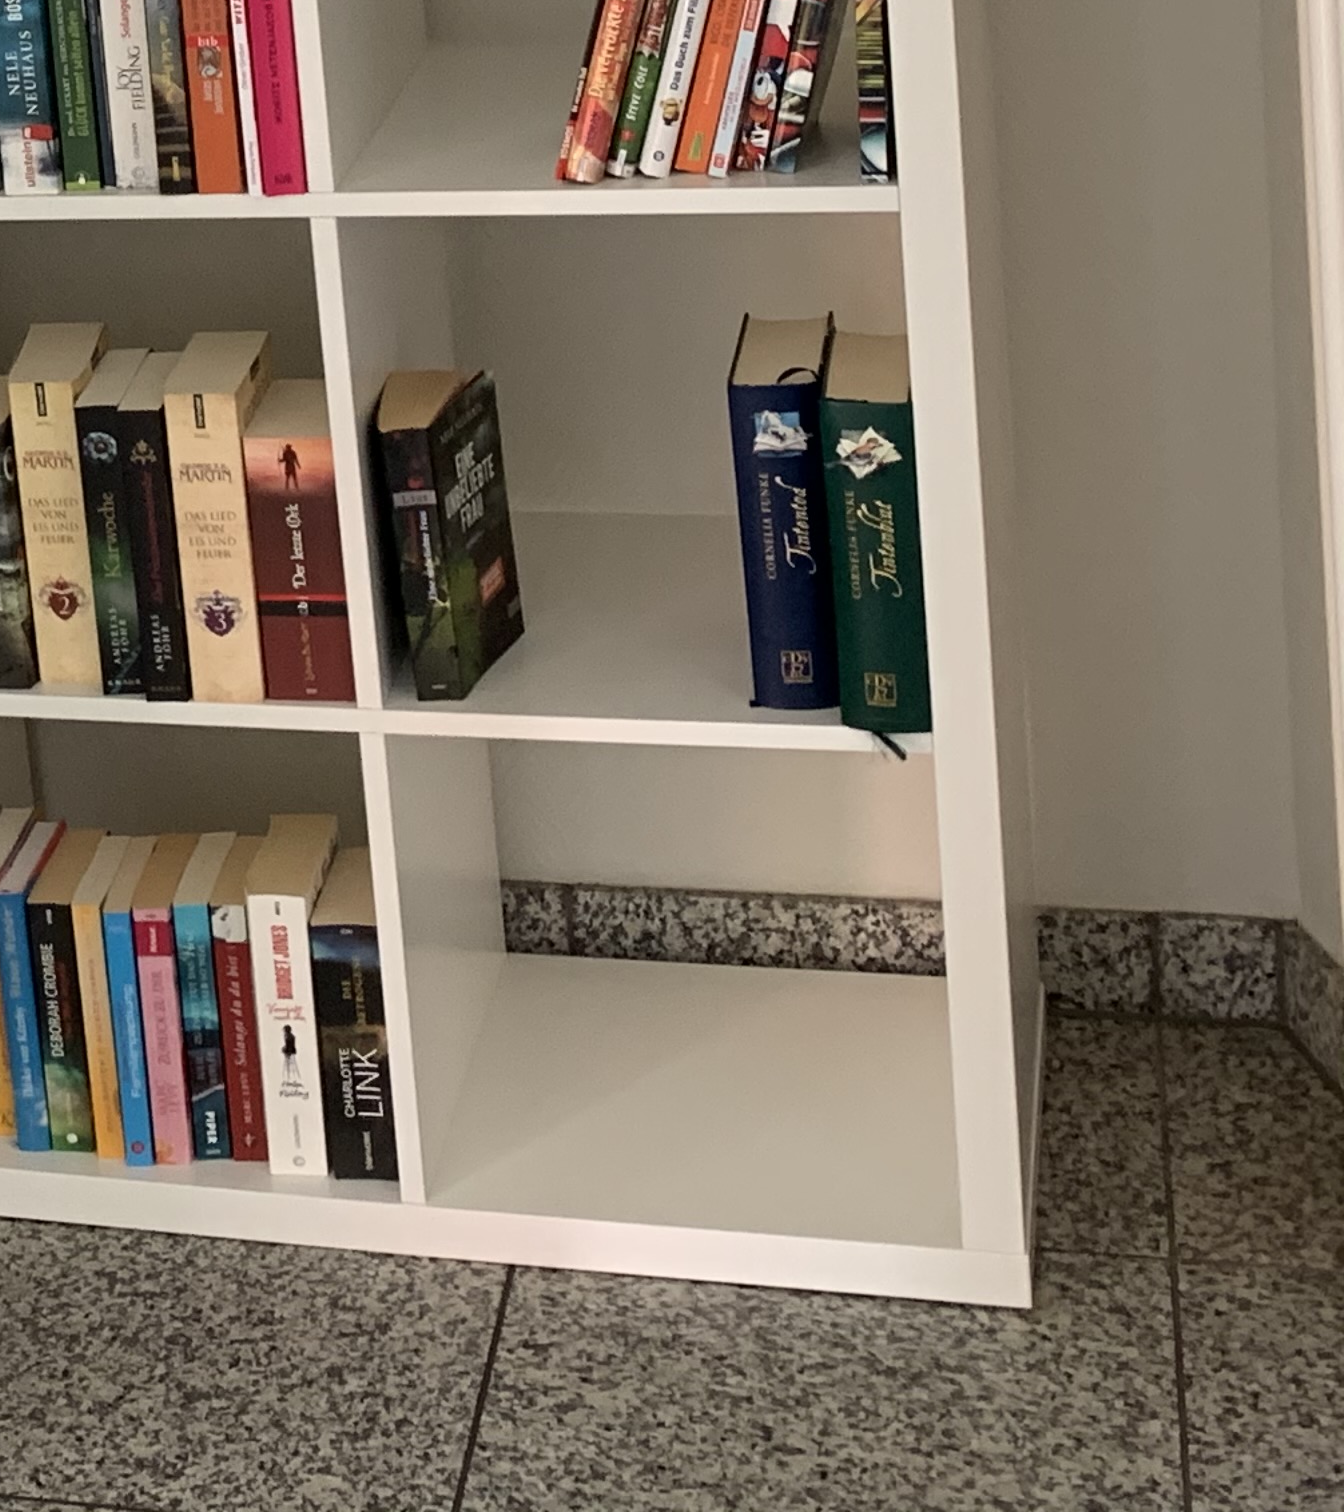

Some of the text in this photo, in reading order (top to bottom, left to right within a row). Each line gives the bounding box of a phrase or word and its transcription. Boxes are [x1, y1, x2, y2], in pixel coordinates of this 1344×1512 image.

[4, 49, 21, 97] NELE
[18, 29, 40, 116] NEUHAUS
[587, 71, 604, 98] Die
[597, 2, 625, 71] verrückte
[668, 72, 681, 92] Das
[675, 41, 689, 72] Buch
[683, 13, 696, 40] zum
[114, 65, 132, 92] JOY
[126, 45, 146, 112] FIELDING
[624, 64, 650, 123] STEVE COLE
[21, 141, 36, 188] ullstein
[22, 454, 76, 471] MARTIN
[178, 468, 233, 484] MARTIN
[40, 509, 67, 521] VON
[50, 521, 79, 533] UND
[97, 491, 122, 579] Karwoche
[184, 510, 237, 523] DAS LIED
[197, 523, 225, 535] VON
[460, 492, 485, 534] FRAU
[758, 471, 780, 581] CORNELIA FUNKE
[774, 475, 817, 575] Tintentod
[195, 549, 232, 561] FEUER
[208, 536, 237, 548] UND
[843, 488, 863, 601] CORNELIA FUNKE
[856, 497, 904, 599] Tintenblut
[291, 564, 306, 590] Der
[58, 596, 71, 616] 2
[214, 609, 227, 631] 3
[107, 607, 122, 665] ANDREAS
[149, 613, 165, 674] ANDREAS
[269, 924, 291, 960] JONES
[228, 955, 240, 980] bist
[40, 942, 66, 1057] DEBORAH CROMBIE
[234, 1019, 249, 1067] Solange
[337, 1046, 354, 1119] CHARLOTTE
[351, 1047, 385, 1120] LINK
[206, 1110, 219, 1144] PIPER
